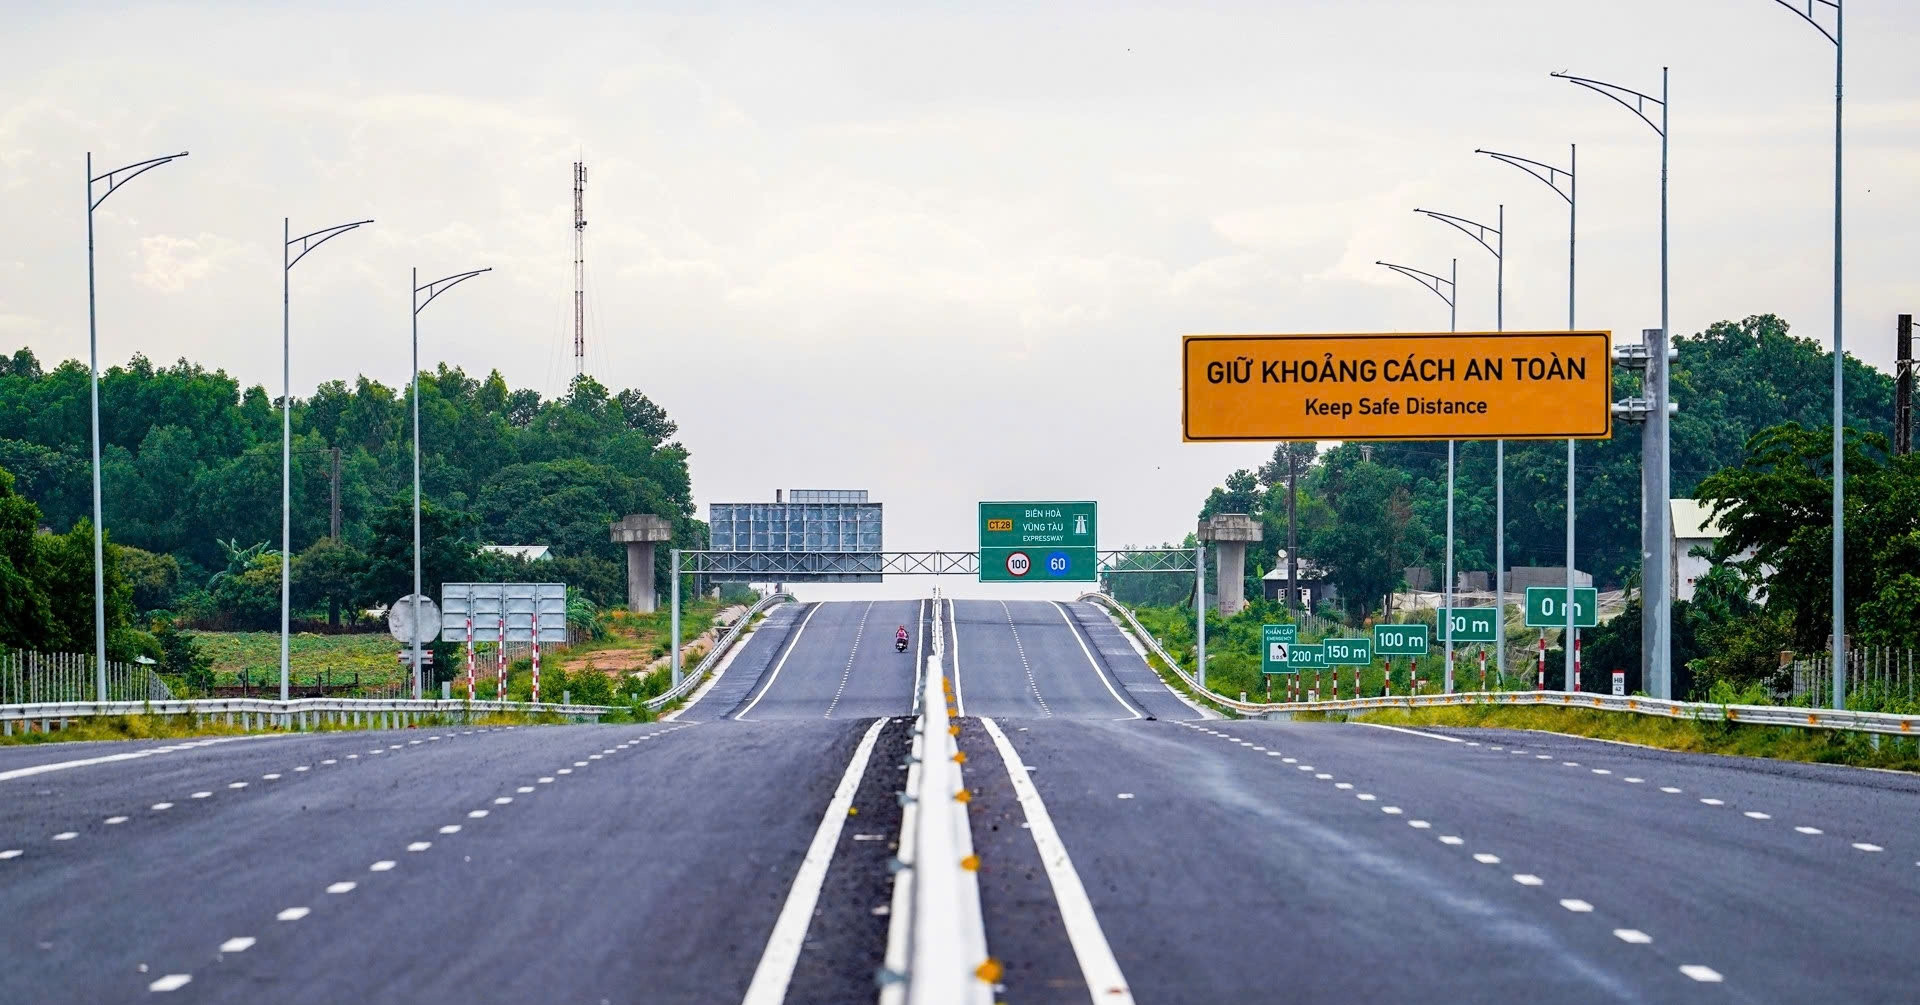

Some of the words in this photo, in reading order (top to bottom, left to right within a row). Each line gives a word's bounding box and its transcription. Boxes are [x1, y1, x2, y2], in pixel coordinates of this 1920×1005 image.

[1207, 356, 1254, 384] GIỮ
[1262, 352, 1377, 383] KHOẢNG
[1383, 353, 1455, 382] CÁCH
[1463, 358, 1503, 381] AN
[1511, 352, 1586, 381] TOÀN
[1305, 398, 1353, 419] Keep
[1359, 398, 1400, 415] Safe
[1406, 397, 1488, 415] Distance
[1045, 507, 1062, 518] HOÀ
[989, 521, 1011, 530] CT.28
[1047, 521, 1064, 532] TÀU
[1011, 559, 1027, 569] 100
[1050, 558, 1066, 571] 60
[1541, 597, 1554, 616] 0
[1561, 602, 1582, 617] m
[1472, 620, 1489, 633] m
[1379, 632, 1403, 647] 100
[1408, 636, 1424, 647] m
[1291, 650, 1312, 662] 200
[1327, 645, 1349, 659] 150
[1353, 648, 1367, 659] m
